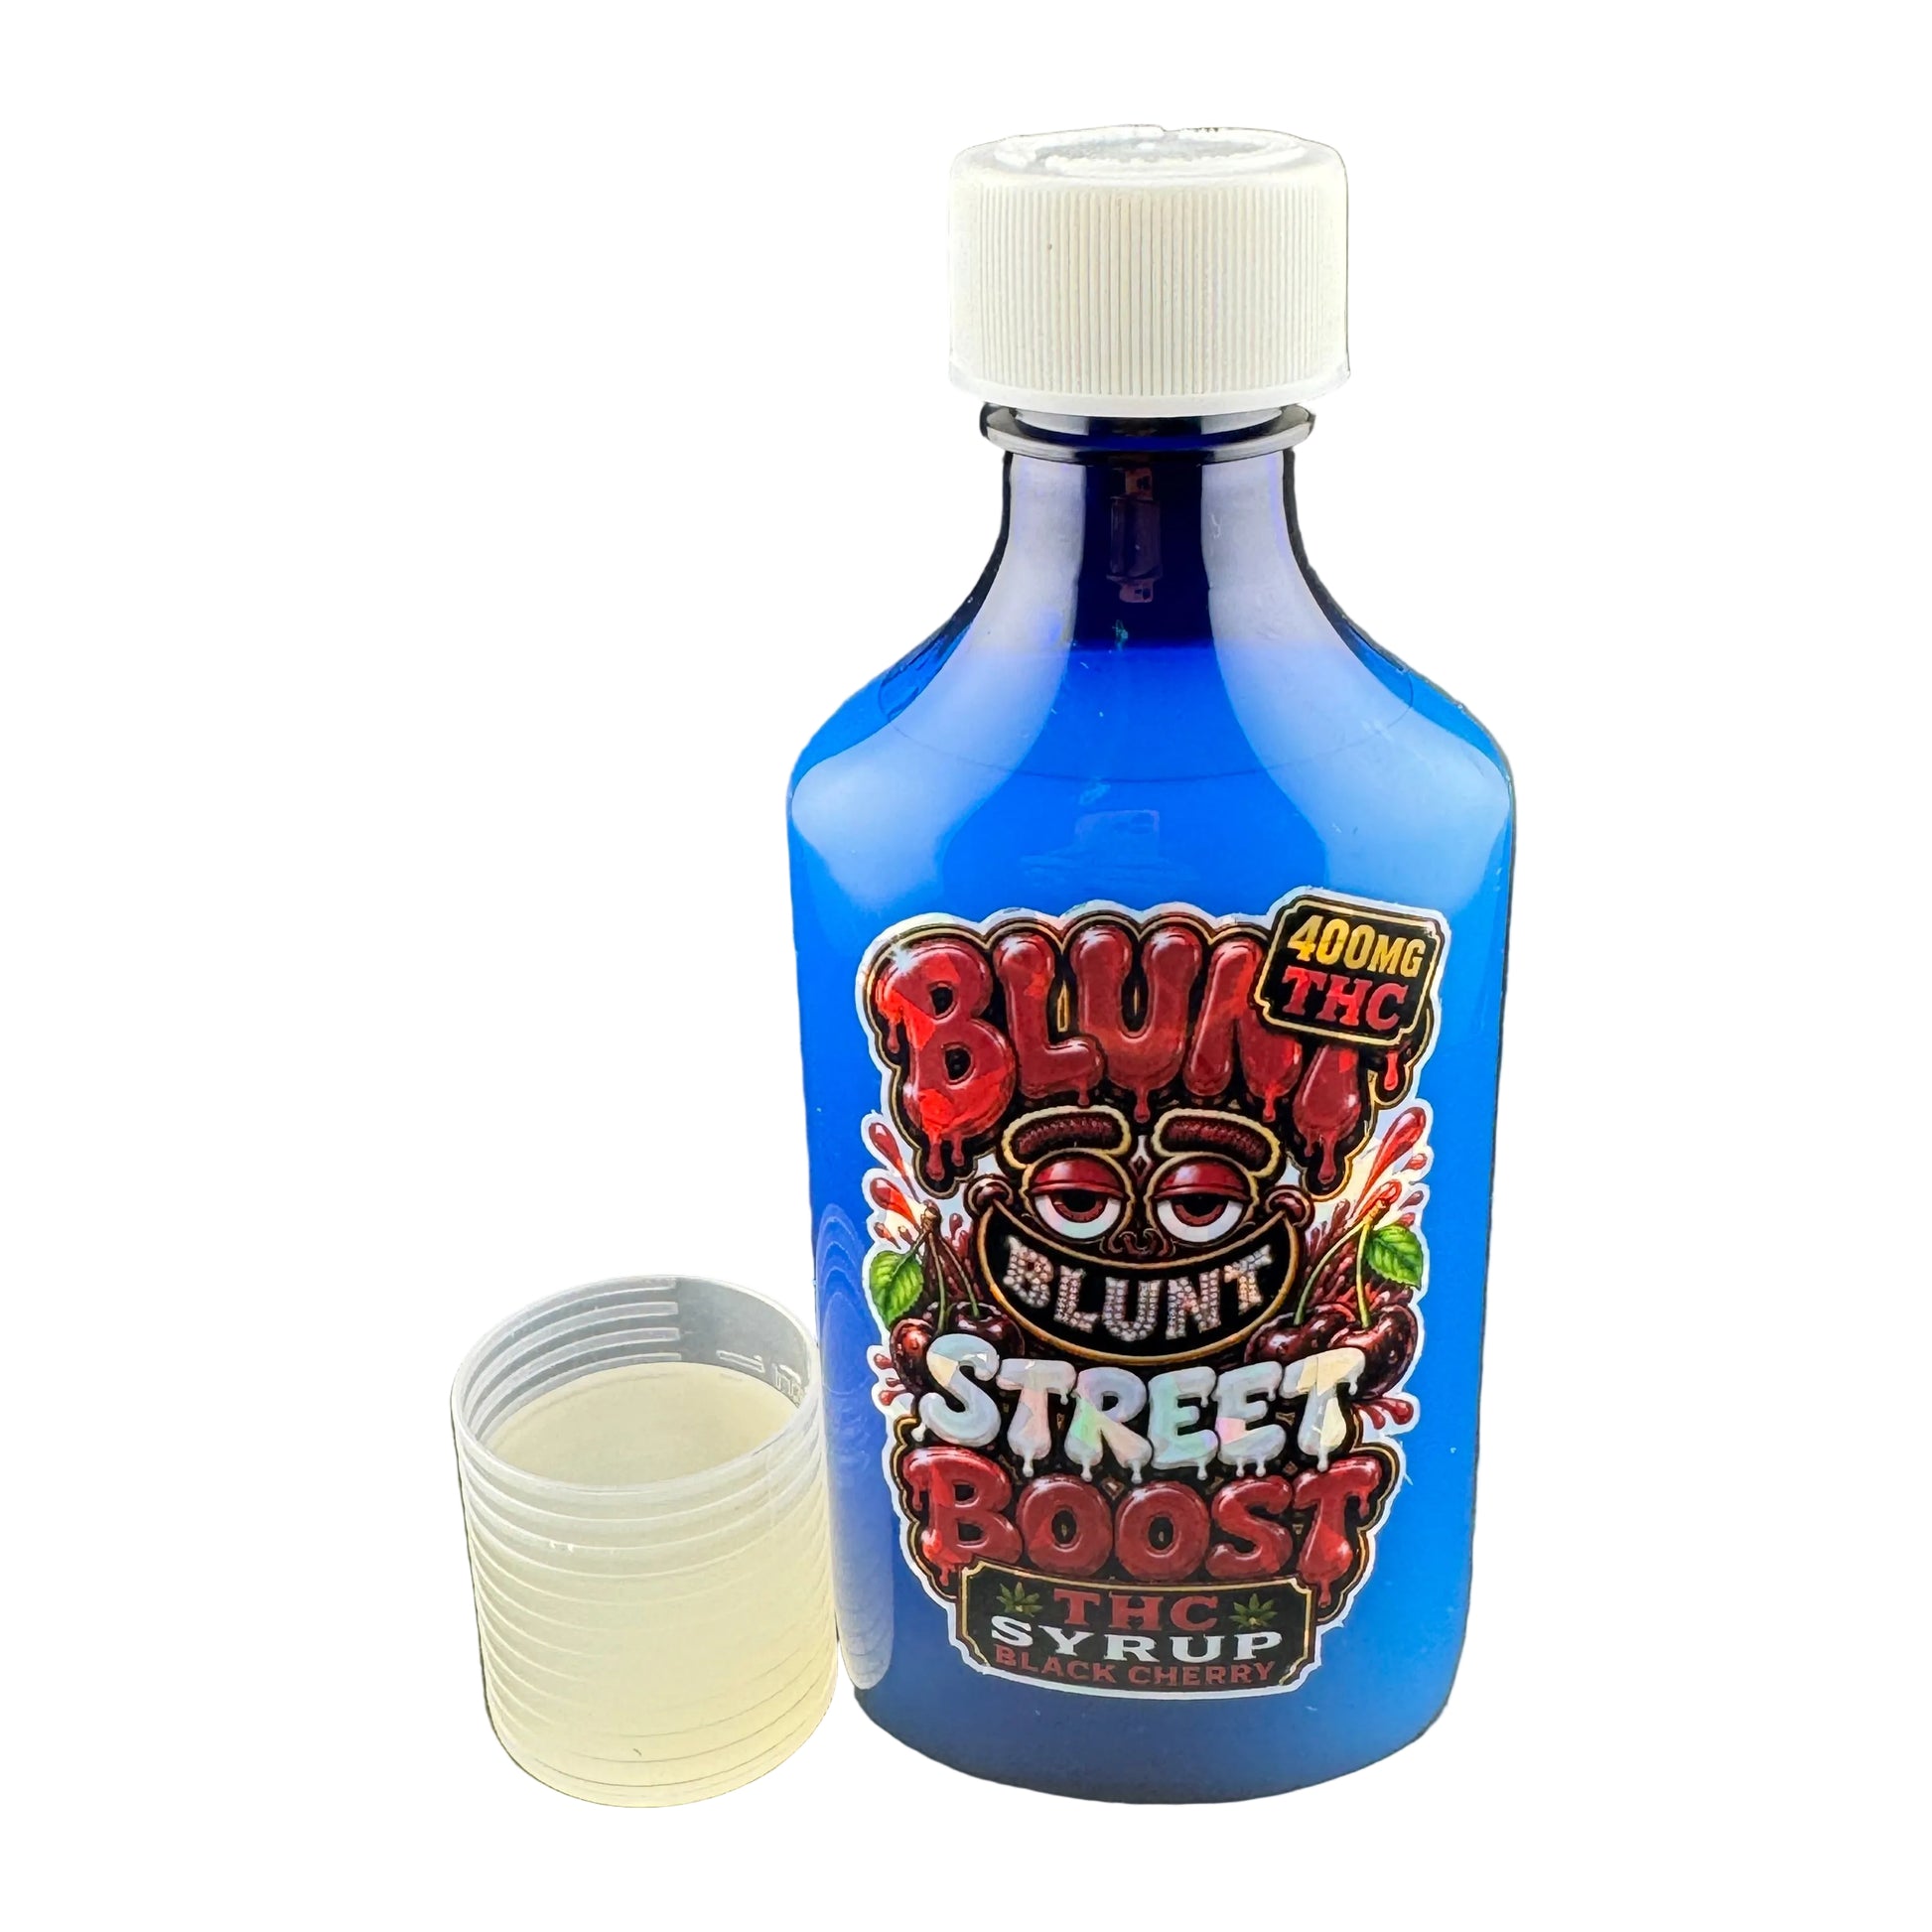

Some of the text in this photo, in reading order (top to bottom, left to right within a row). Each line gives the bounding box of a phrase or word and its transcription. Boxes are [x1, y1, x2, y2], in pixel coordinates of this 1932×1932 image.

[1288, 915, 1426, 979] 400MG
[1282, 966, 1408, 1032] THC
[1003, 1236, 1274, 1341] BLUNT
[914, 1333, 1367, 1482] STREET
[902, 1447, 1383, 1607] BOOST
[991, 1614, 1283, 1663] SYRUP
[1054, 1588, 1218, 1632] THC
[995, 1647, 1277, 1686] BLACK CHERRY
